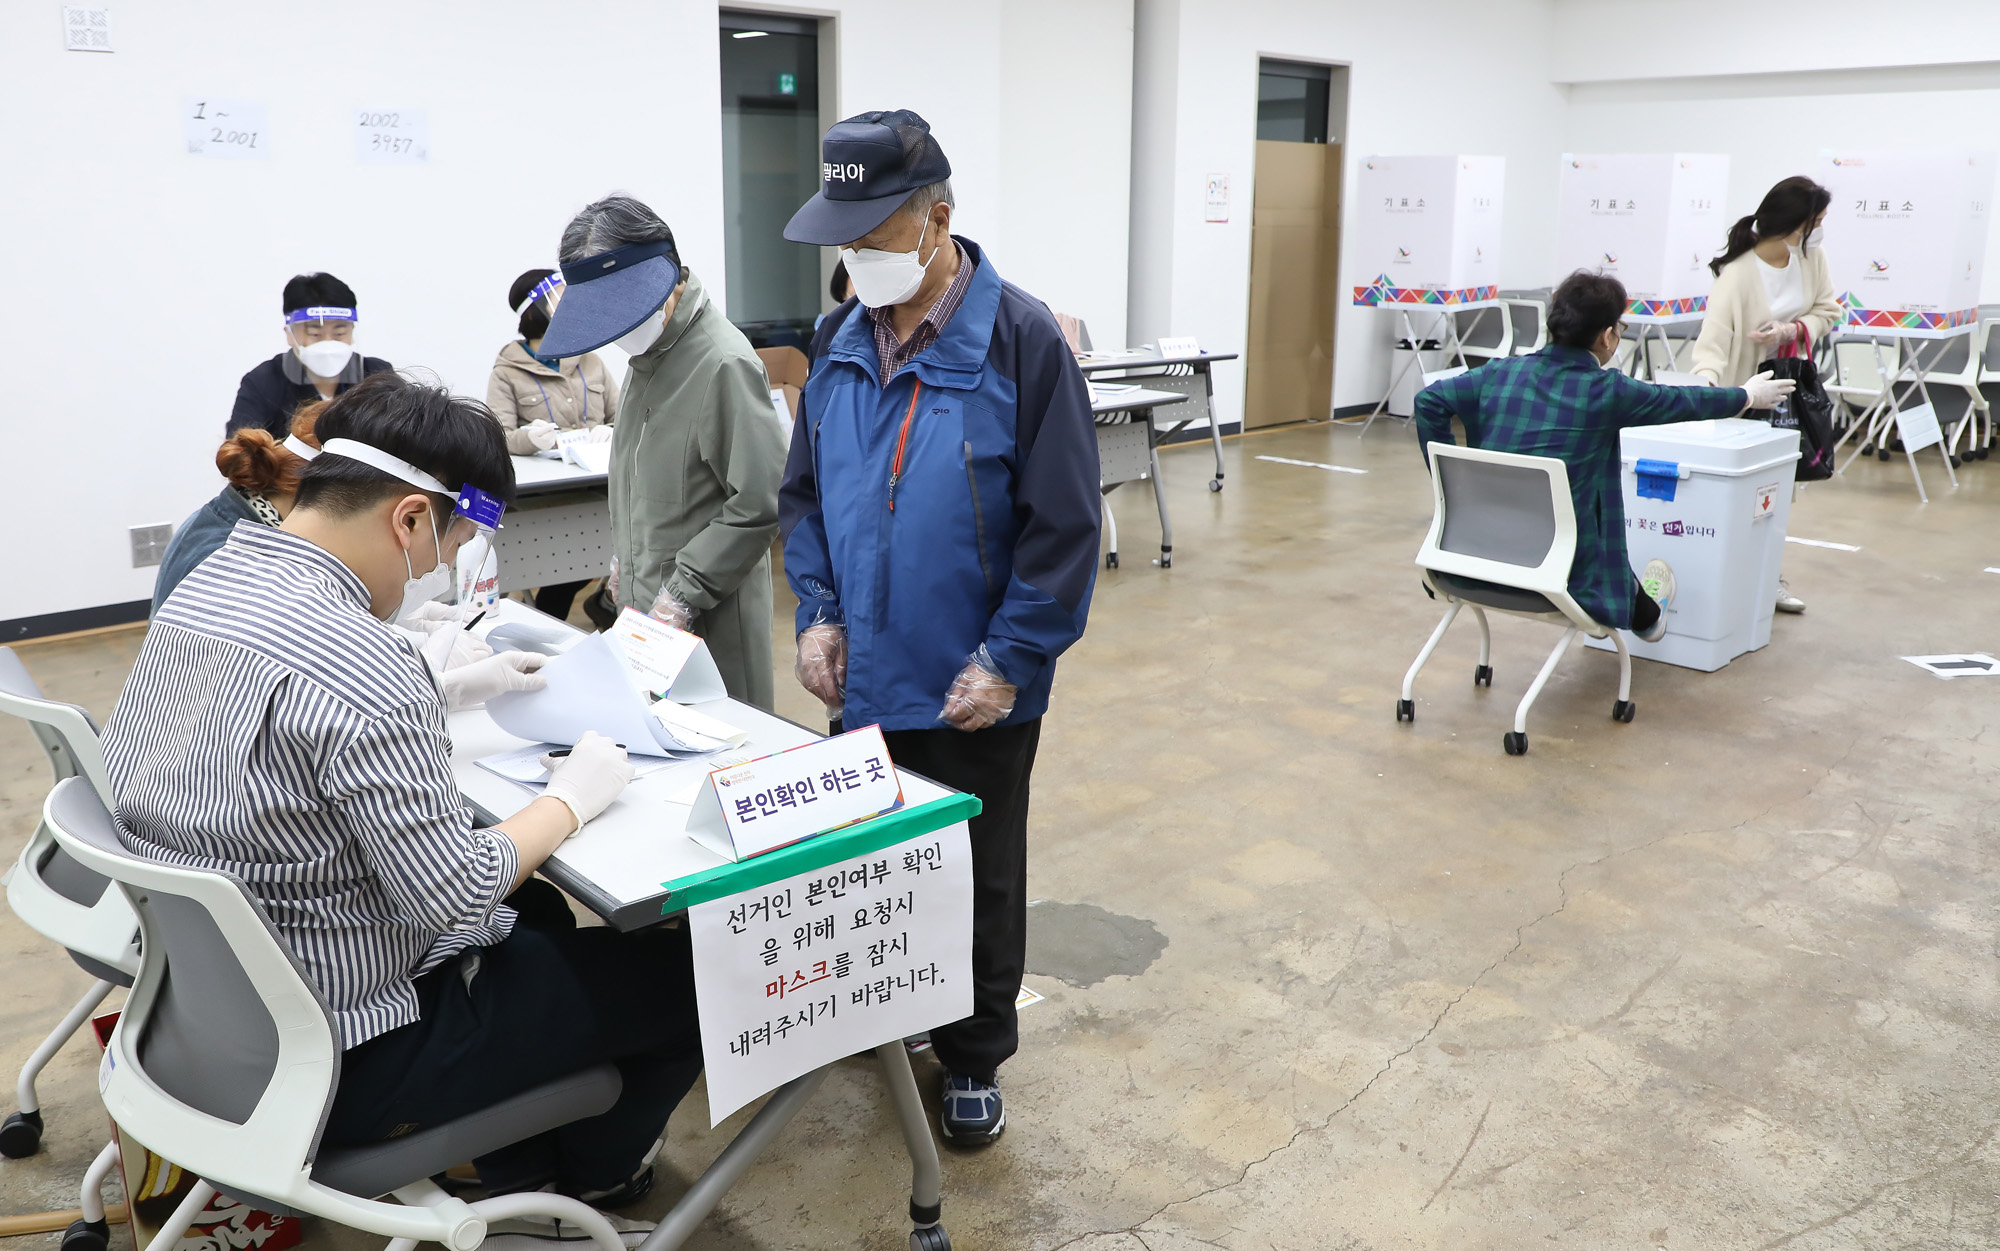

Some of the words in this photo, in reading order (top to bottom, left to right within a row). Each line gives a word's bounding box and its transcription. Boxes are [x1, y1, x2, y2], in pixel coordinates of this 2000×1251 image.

[210, 126, 257, 149] 2001
[371, 133, 414, 154] 3957
[1637, 517, 1658, 531] 꽃은
[1662, 520, 1716, 538] 선거입니다
[735, 777, 818, 823] 본인확인
[819, 767, 862, 793] 하는
[864, 756, 886, 783] 곳
[726, 889, 792, 935] 선거인
[804, 859, 892, 907] 본인여부
[902, 842, 943, 875] 확인
[759, 937, 782, 966] 을
[792, 915, 835, 951] 위해
[850, 891, 914, 931] 요청시
[765, 951, 854, 1000] 마스크를
[866, 932, 908, 968] 잠시
[728, 994, 837, 1057] 내려주시기
[851, 962, 946, 1007] 바랍니다.
